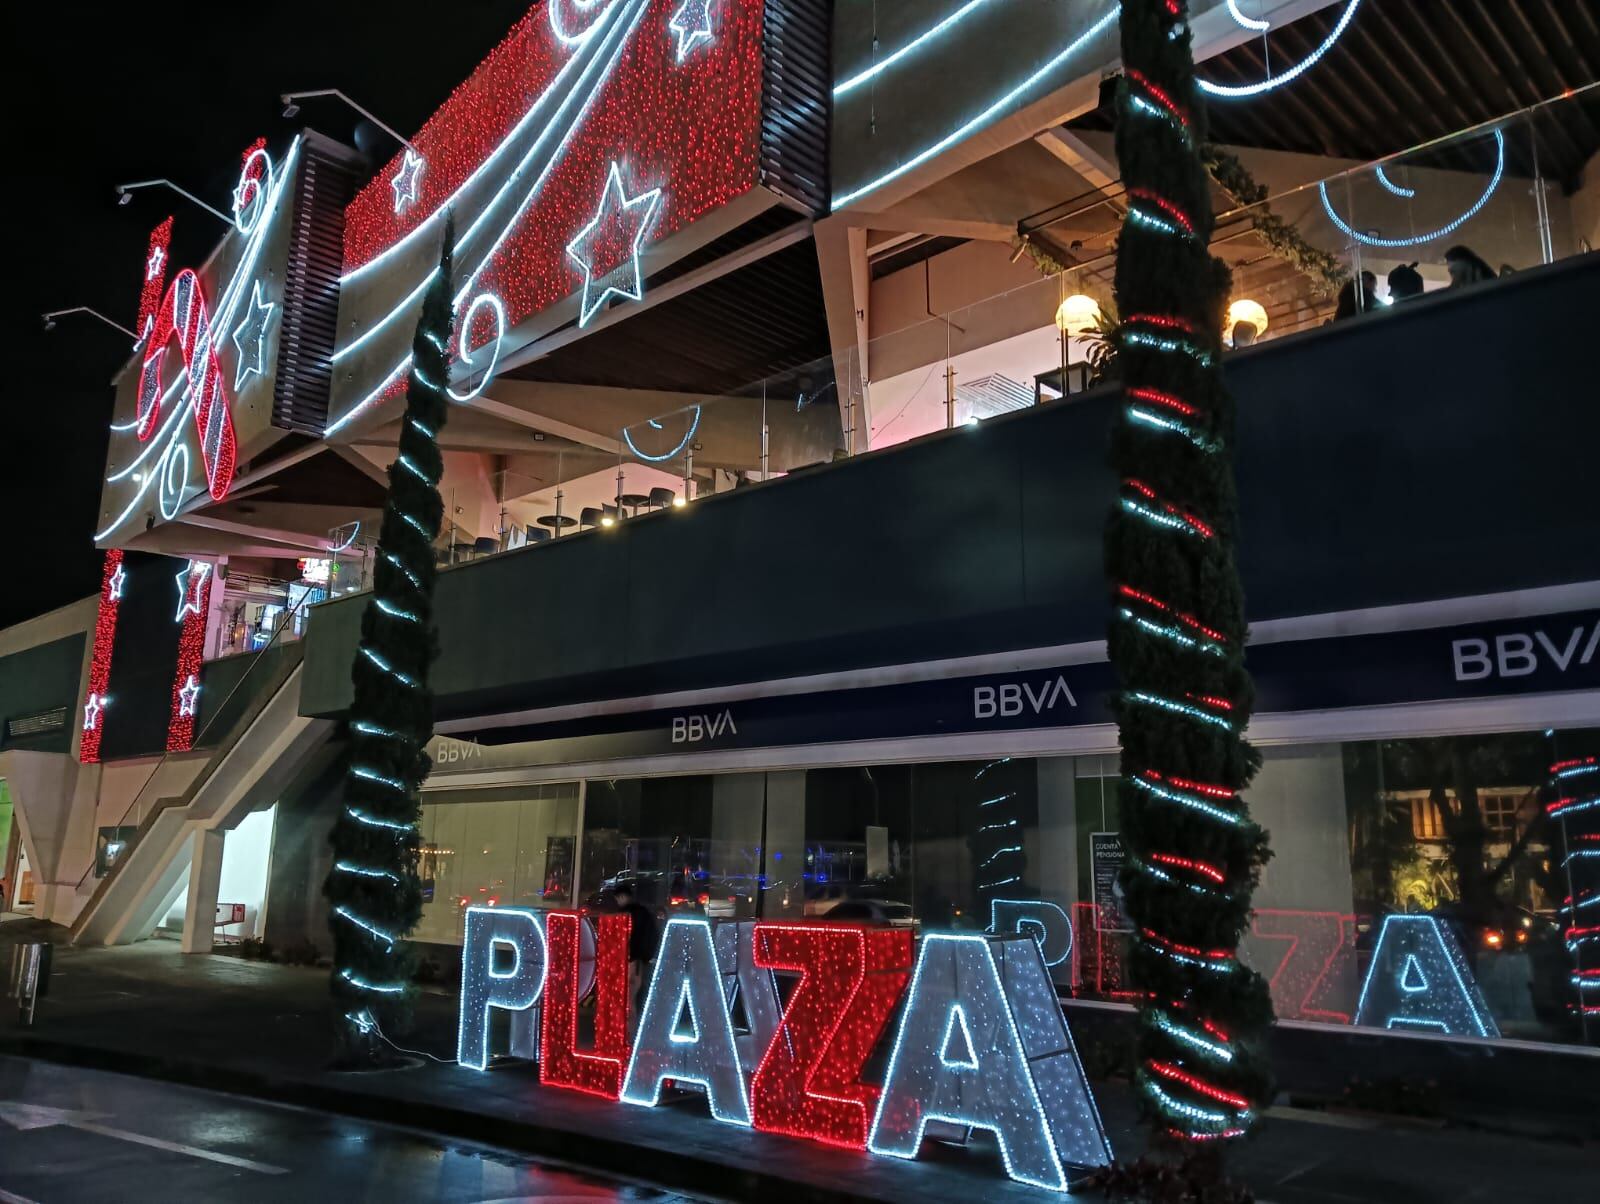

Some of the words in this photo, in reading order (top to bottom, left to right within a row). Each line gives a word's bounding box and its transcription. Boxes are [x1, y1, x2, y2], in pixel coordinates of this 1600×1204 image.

[974, 675, 1077, 718] BBVA
[671, 708, 737, 743] BBVA
[437, 736, 481, 763] BBVA
[456, 906, 1112, 1193] PLAZA
